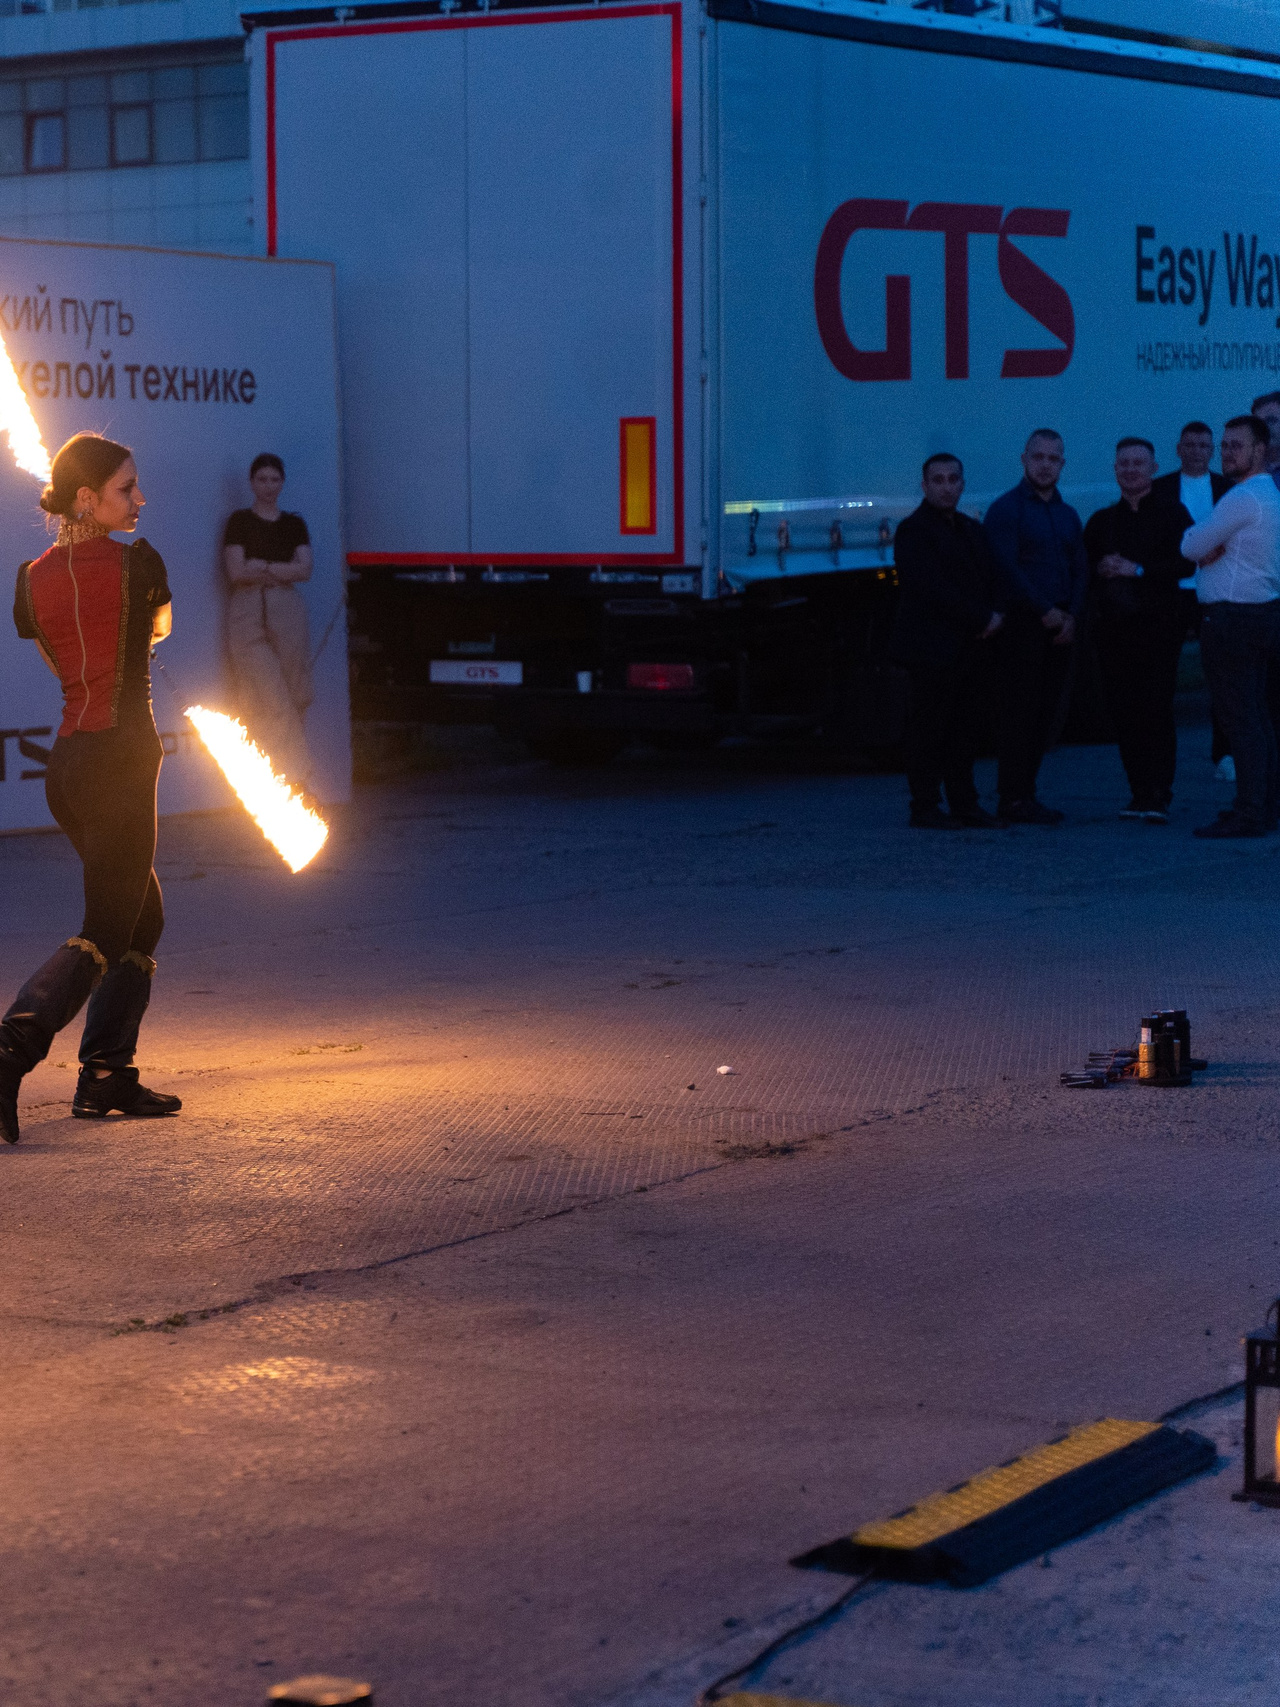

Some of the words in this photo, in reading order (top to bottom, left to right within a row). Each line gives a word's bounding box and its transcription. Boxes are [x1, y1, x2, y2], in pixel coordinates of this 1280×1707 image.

[814, 197, 1075, 382] GTS
[1136, 224, 1216, 326] Easy
[60, 297, 134, 349] путь
[124, 363, 257, 405] технике
[465, 666, 500, 680] GTS
